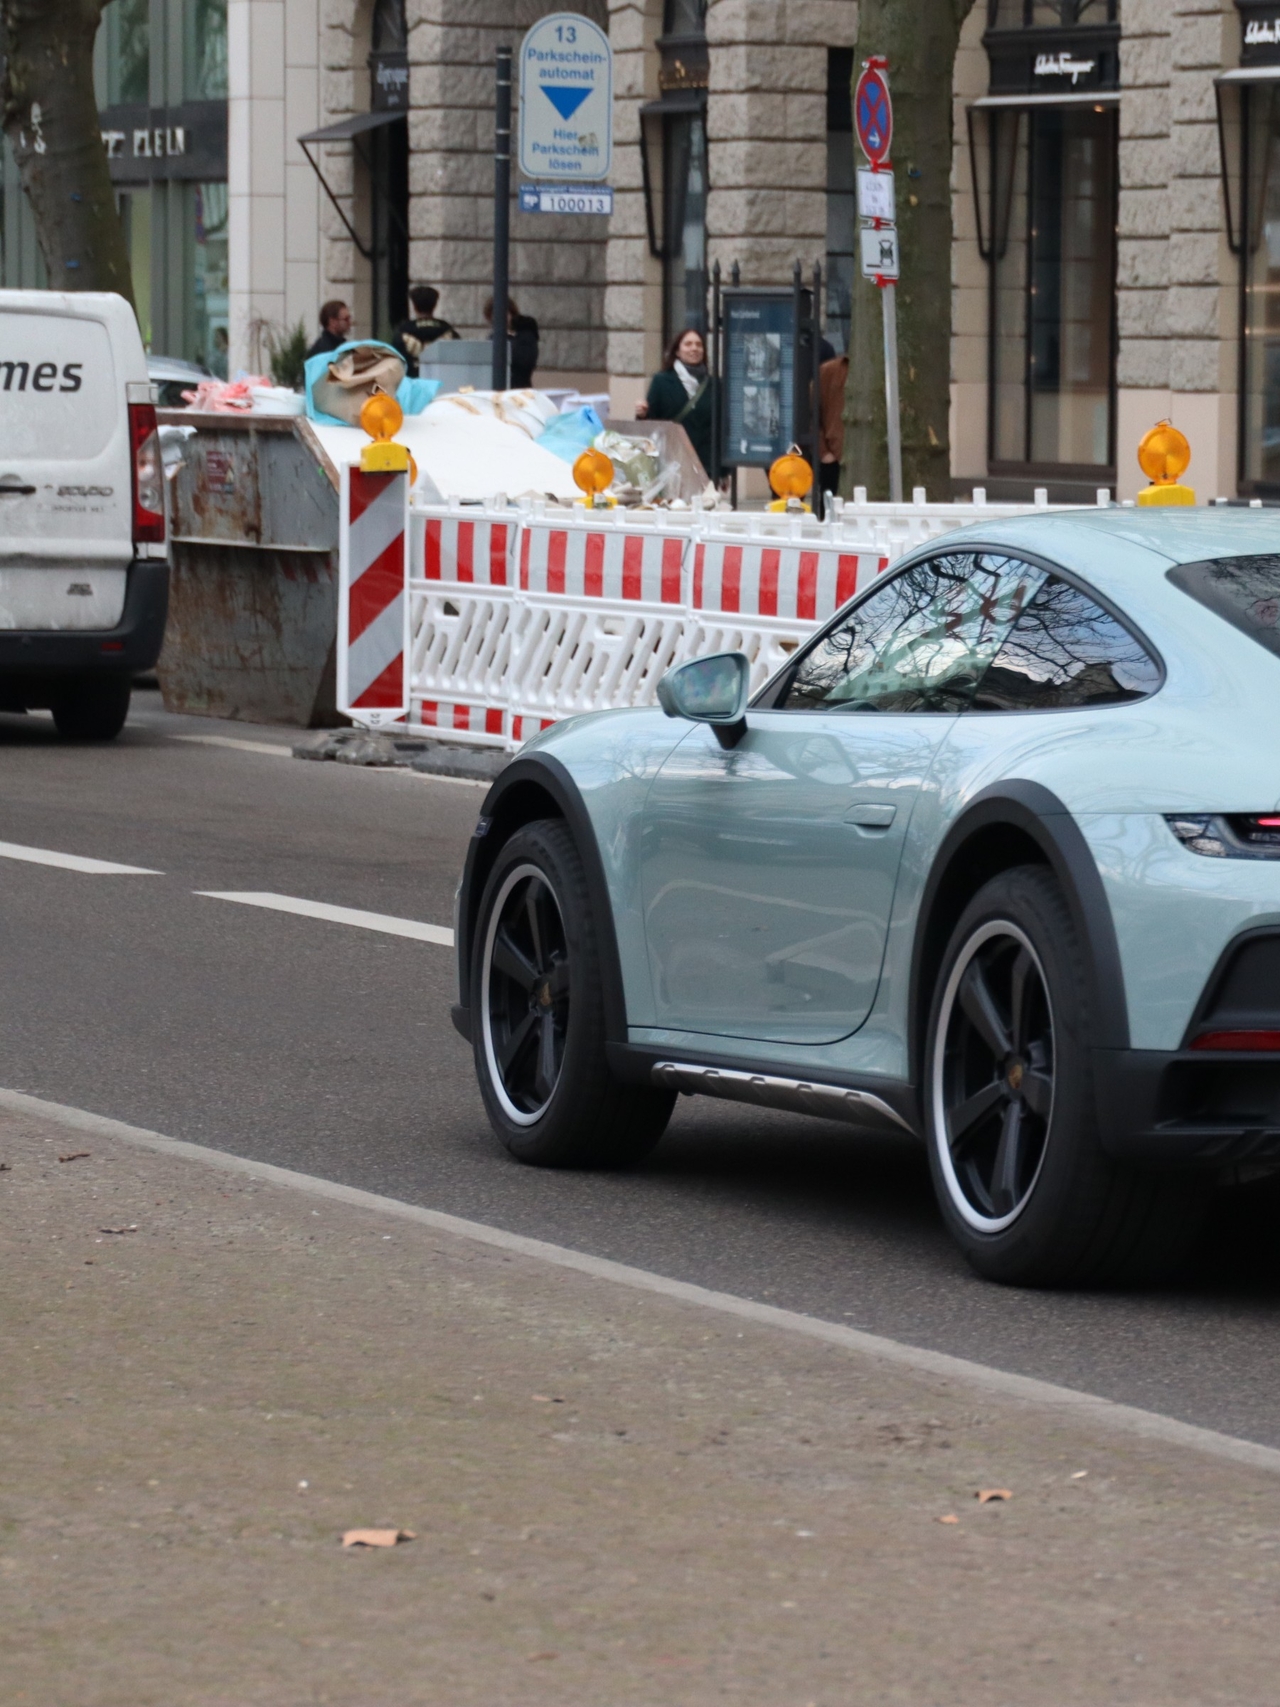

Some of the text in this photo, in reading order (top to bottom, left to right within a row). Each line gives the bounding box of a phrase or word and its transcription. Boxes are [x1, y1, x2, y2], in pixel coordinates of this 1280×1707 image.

[555, 25, 577, 44] 13
[527, 48, 607, 63] Parkschein-
[539, 66, 595, 80] automat
[553, 128, 578, 139] Hier
[532, 143, 599, 156] Parkschein
[548, 159, 582, 170] lösen
[550, 198, 604, 213] 100013
